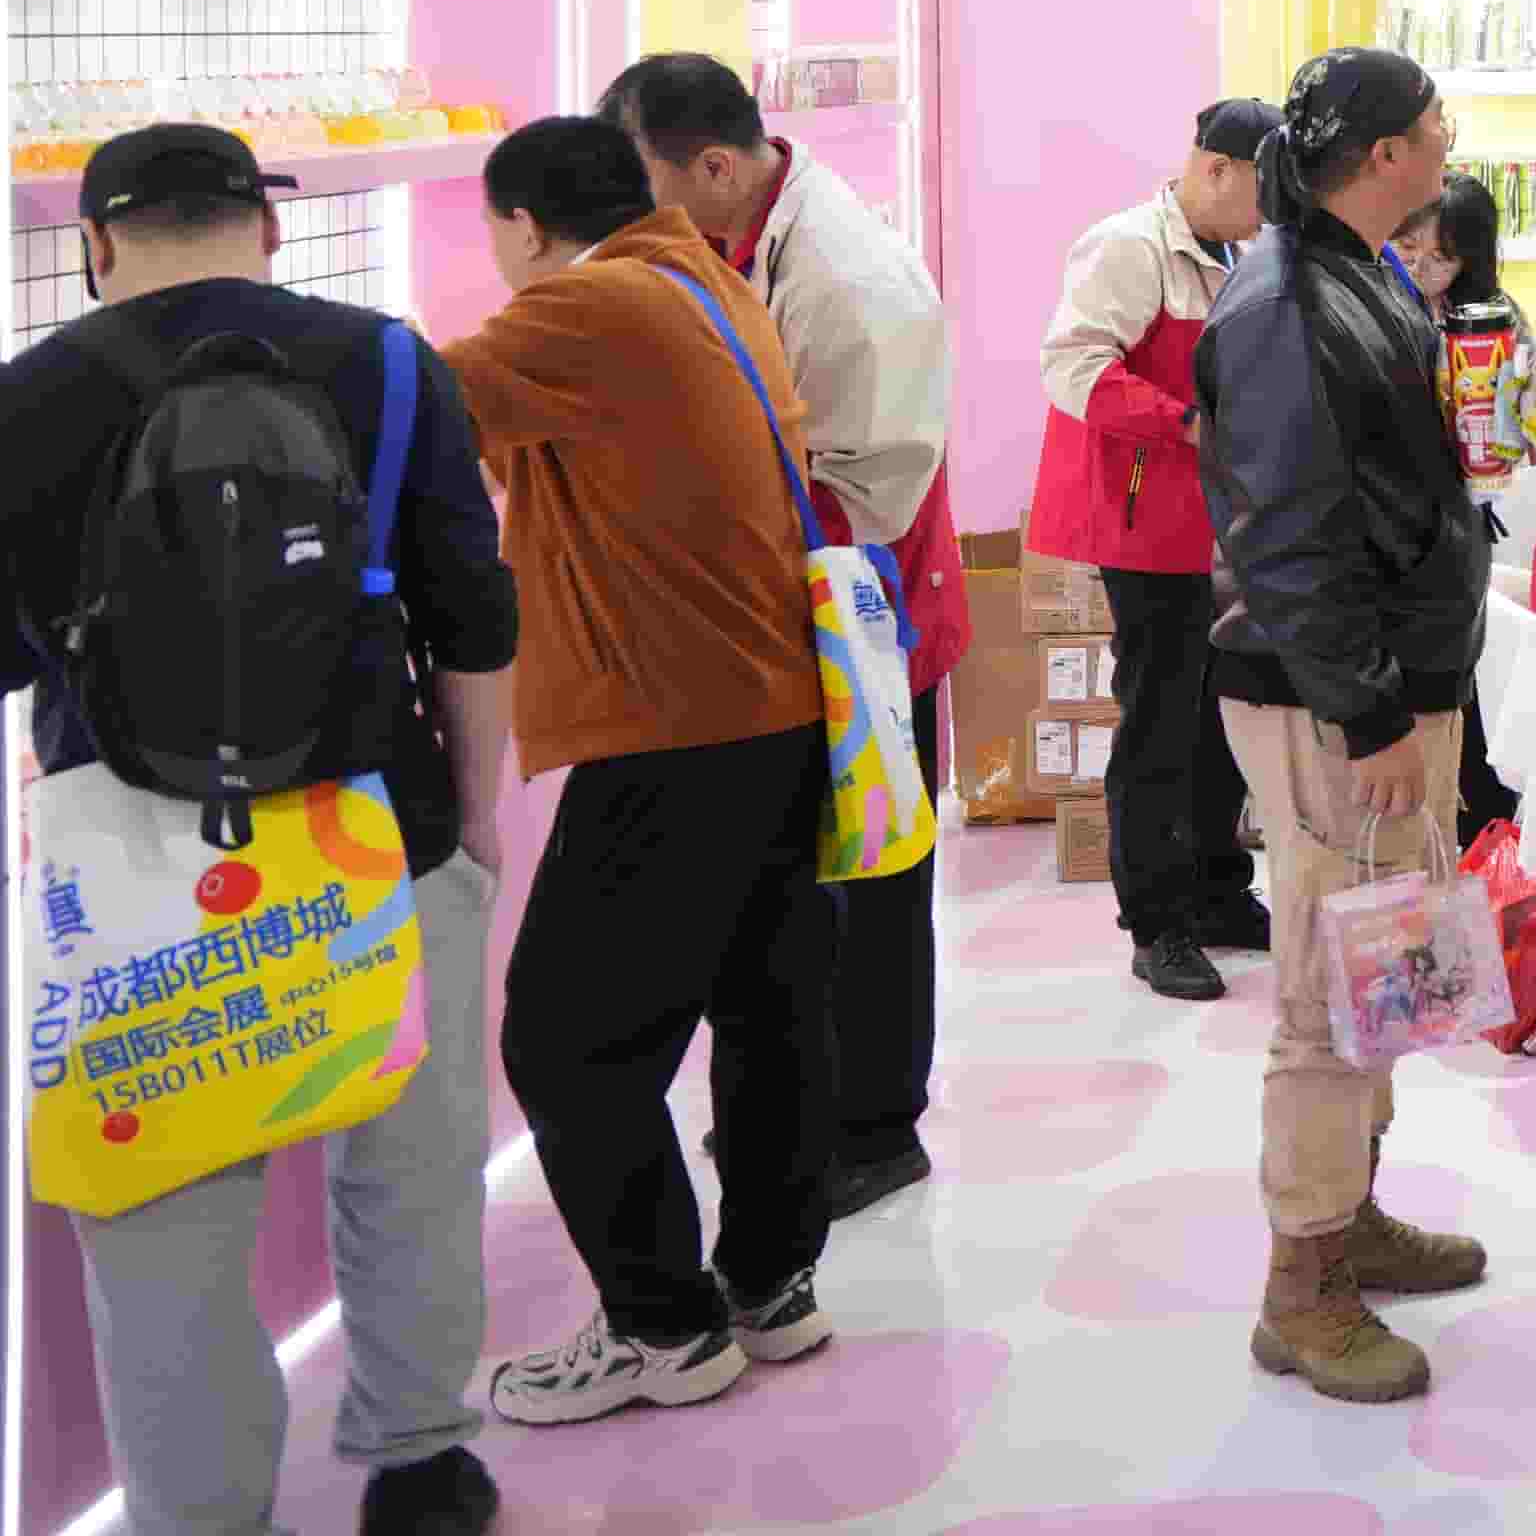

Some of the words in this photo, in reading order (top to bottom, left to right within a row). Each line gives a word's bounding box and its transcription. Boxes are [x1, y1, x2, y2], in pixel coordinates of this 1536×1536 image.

[77, 880, 353, 1029] 成都西博城
[80, 983, 273, 1081] 国际会展
[91, 1007, 334, 1114] 15B011T展位
